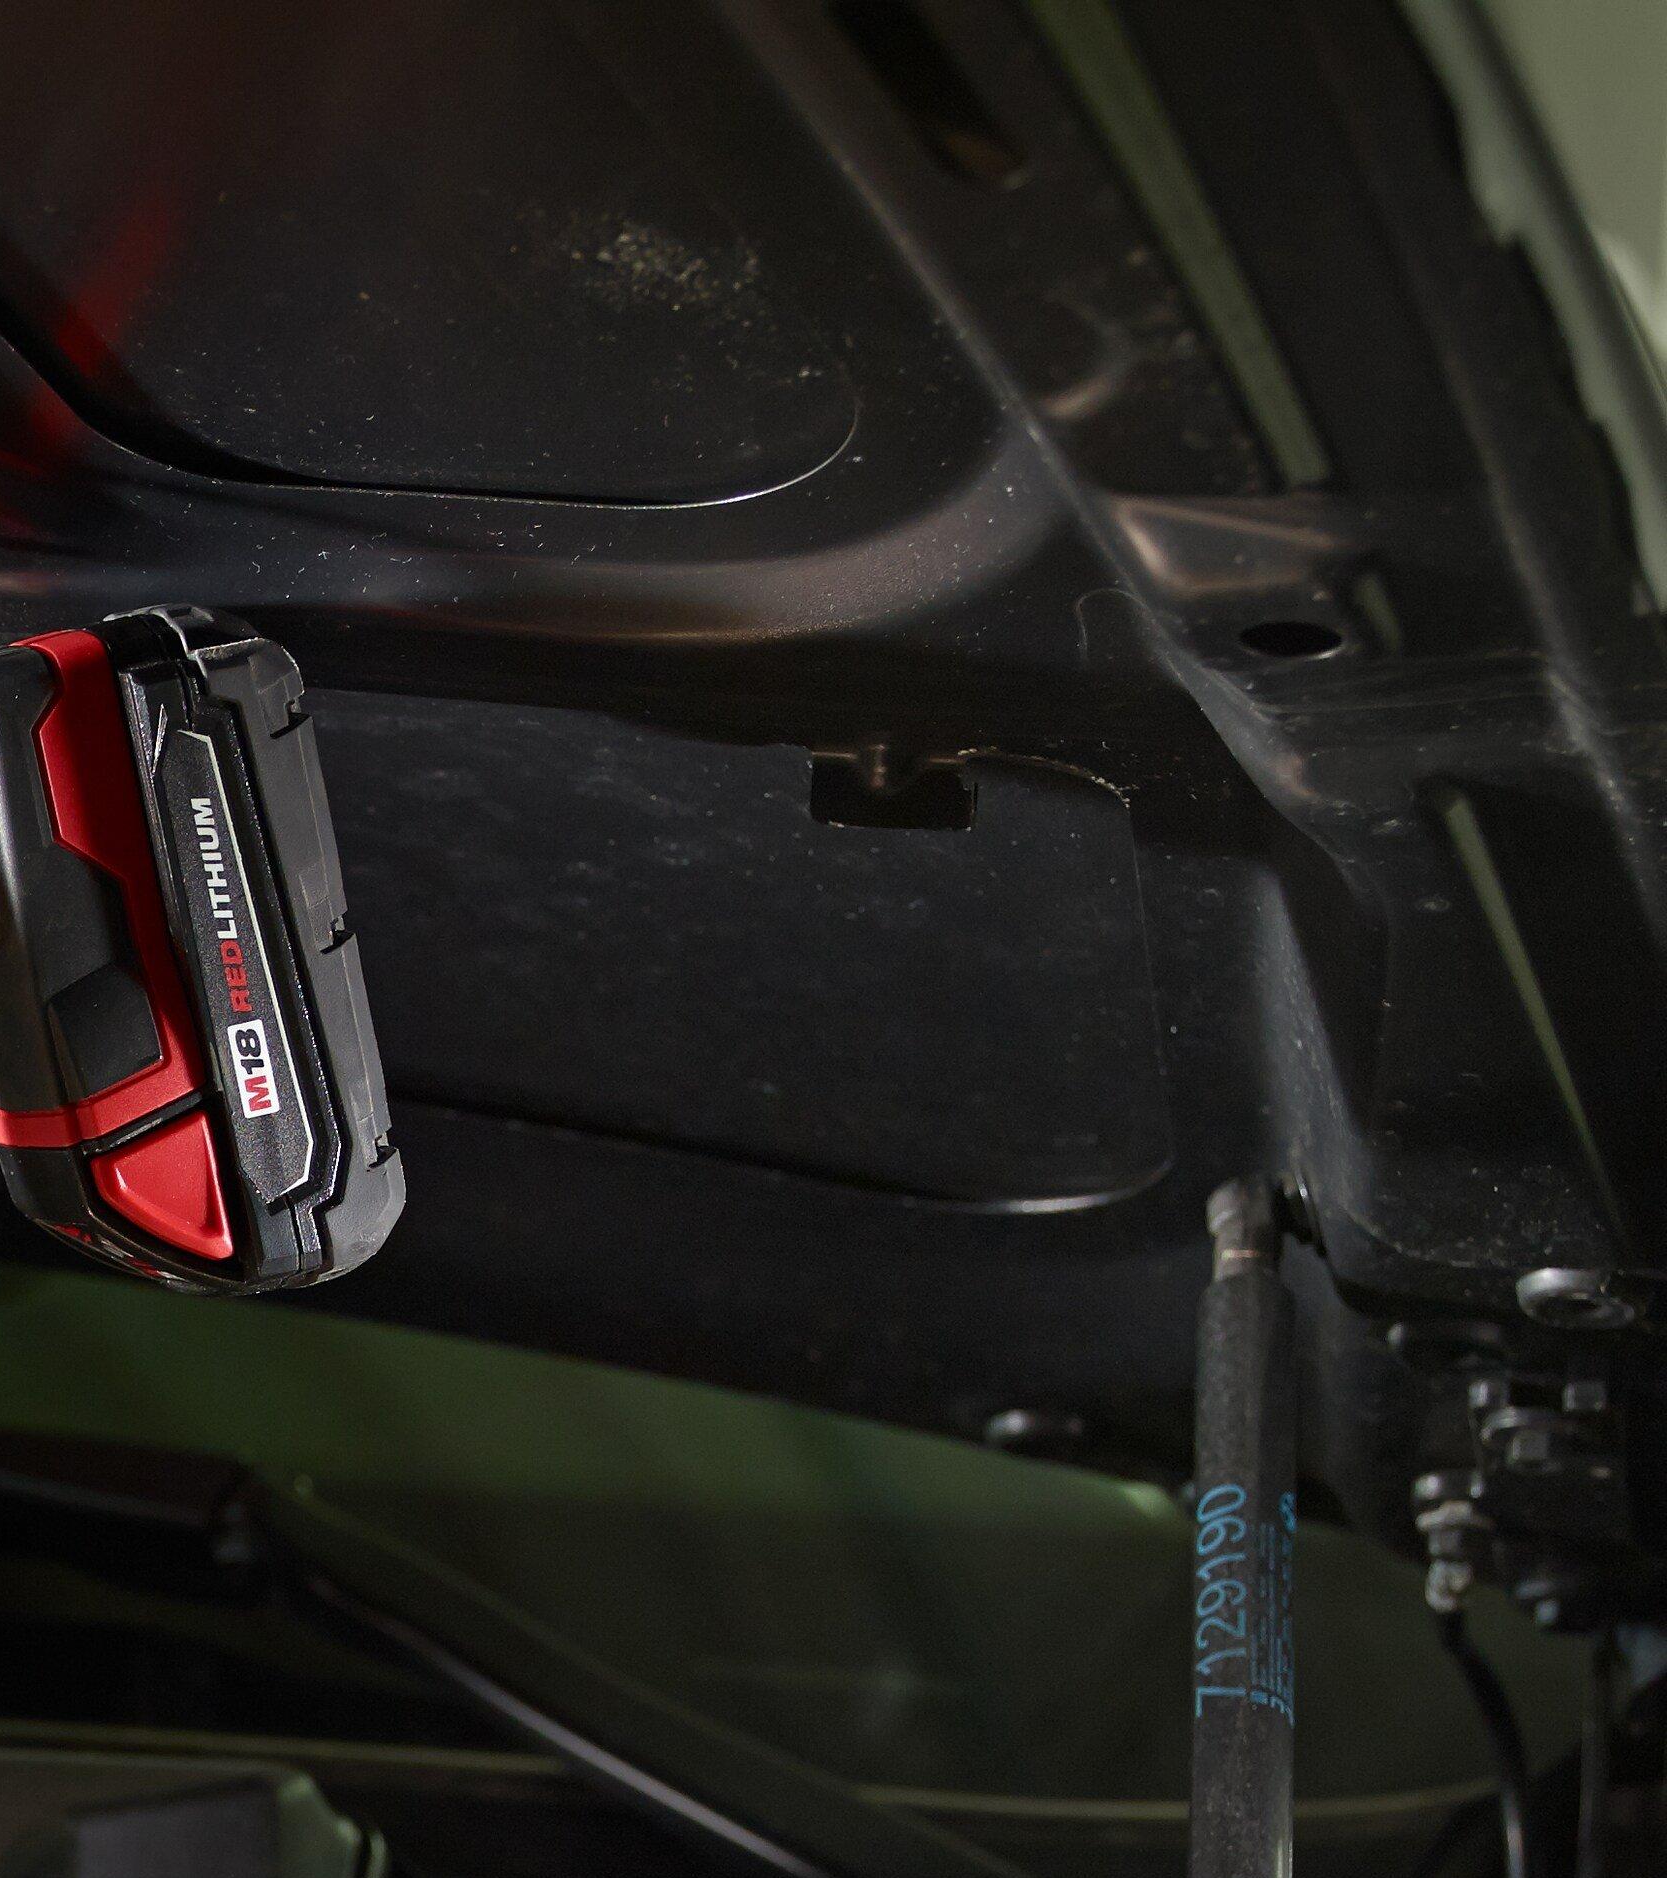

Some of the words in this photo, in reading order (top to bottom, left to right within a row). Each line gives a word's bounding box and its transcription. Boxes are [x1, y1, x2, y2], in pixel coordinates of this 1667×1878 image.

[191, 798, 252, 1013] REDLITHIUM
[235, 1028, 273, 1113] M18
[1196, 1484, 1247, 1718] 7129190
